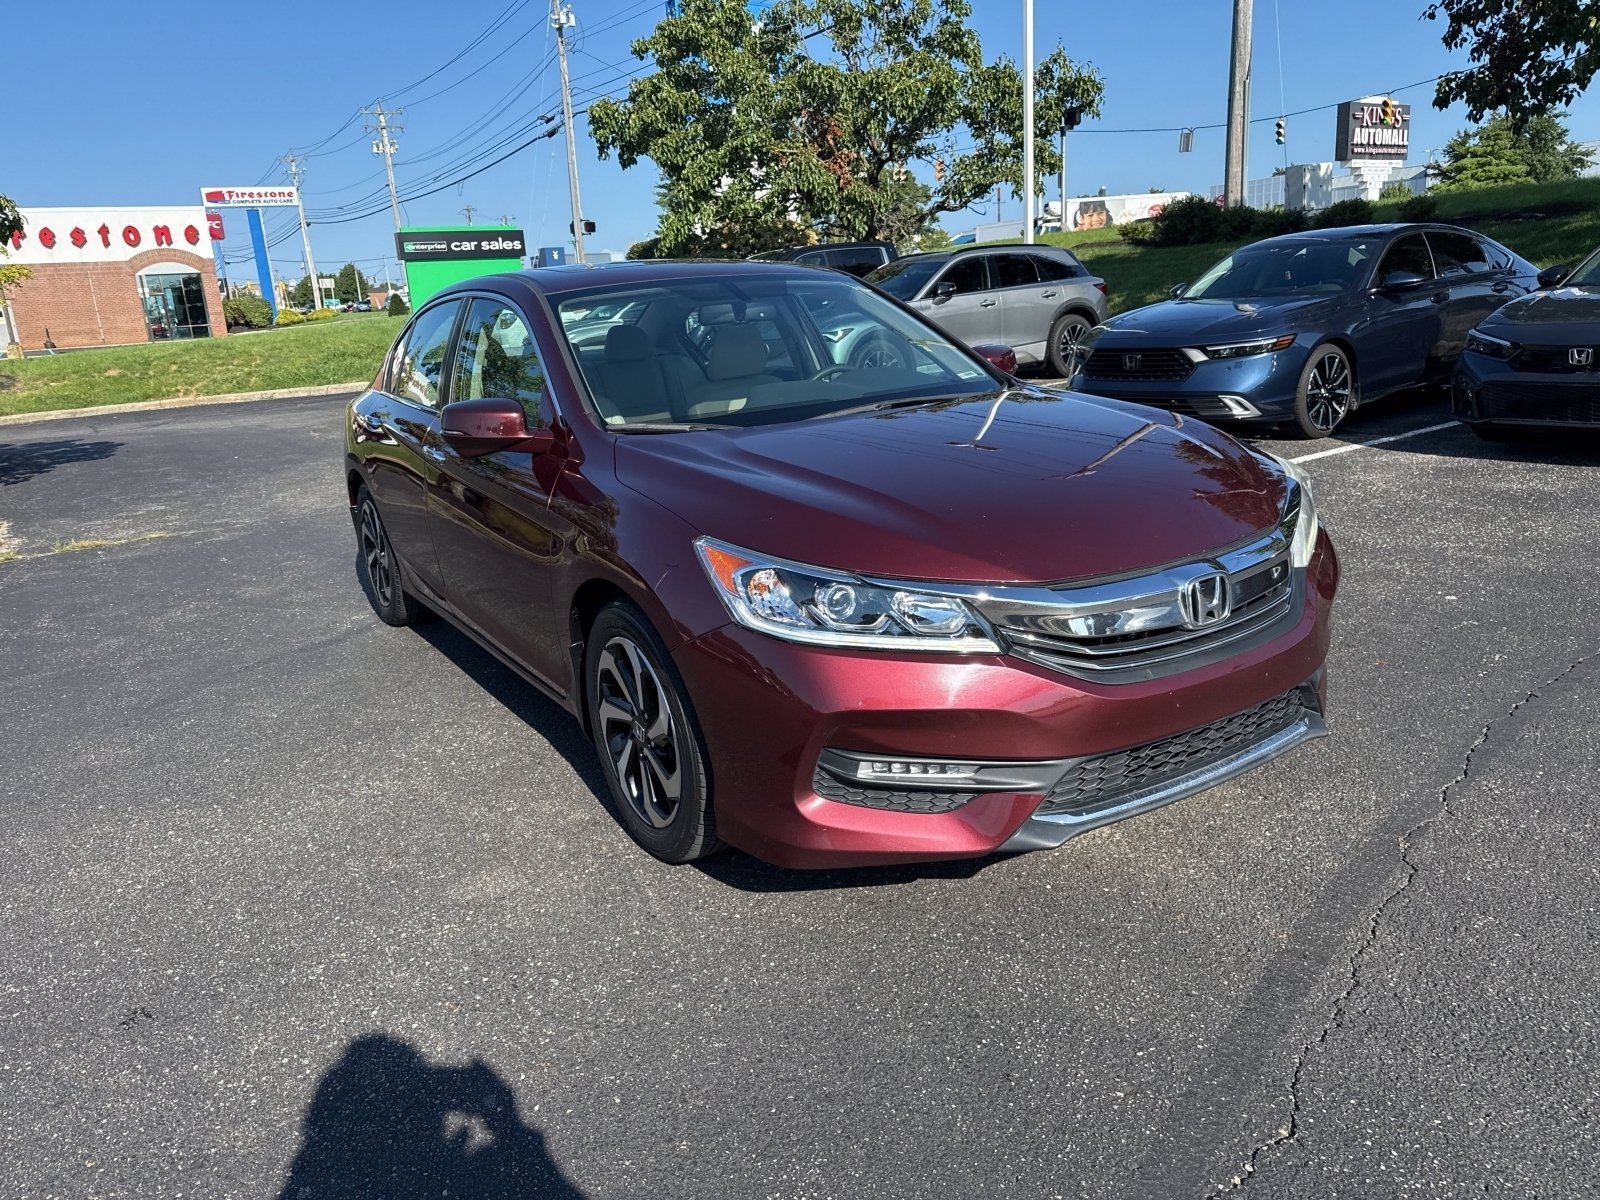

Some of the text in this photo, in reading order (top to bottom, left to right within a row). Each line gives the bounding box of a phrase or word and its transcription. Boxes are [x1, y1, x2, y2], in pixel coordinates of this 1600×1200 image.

[1354, 127, 1408, 145] AUTOMALL
[1354, 146, 1407, 154] www.kingsautomall.com
[226, 190, 294, 200] Firestone
[405, 236, 522, 251] enterprise car sales
